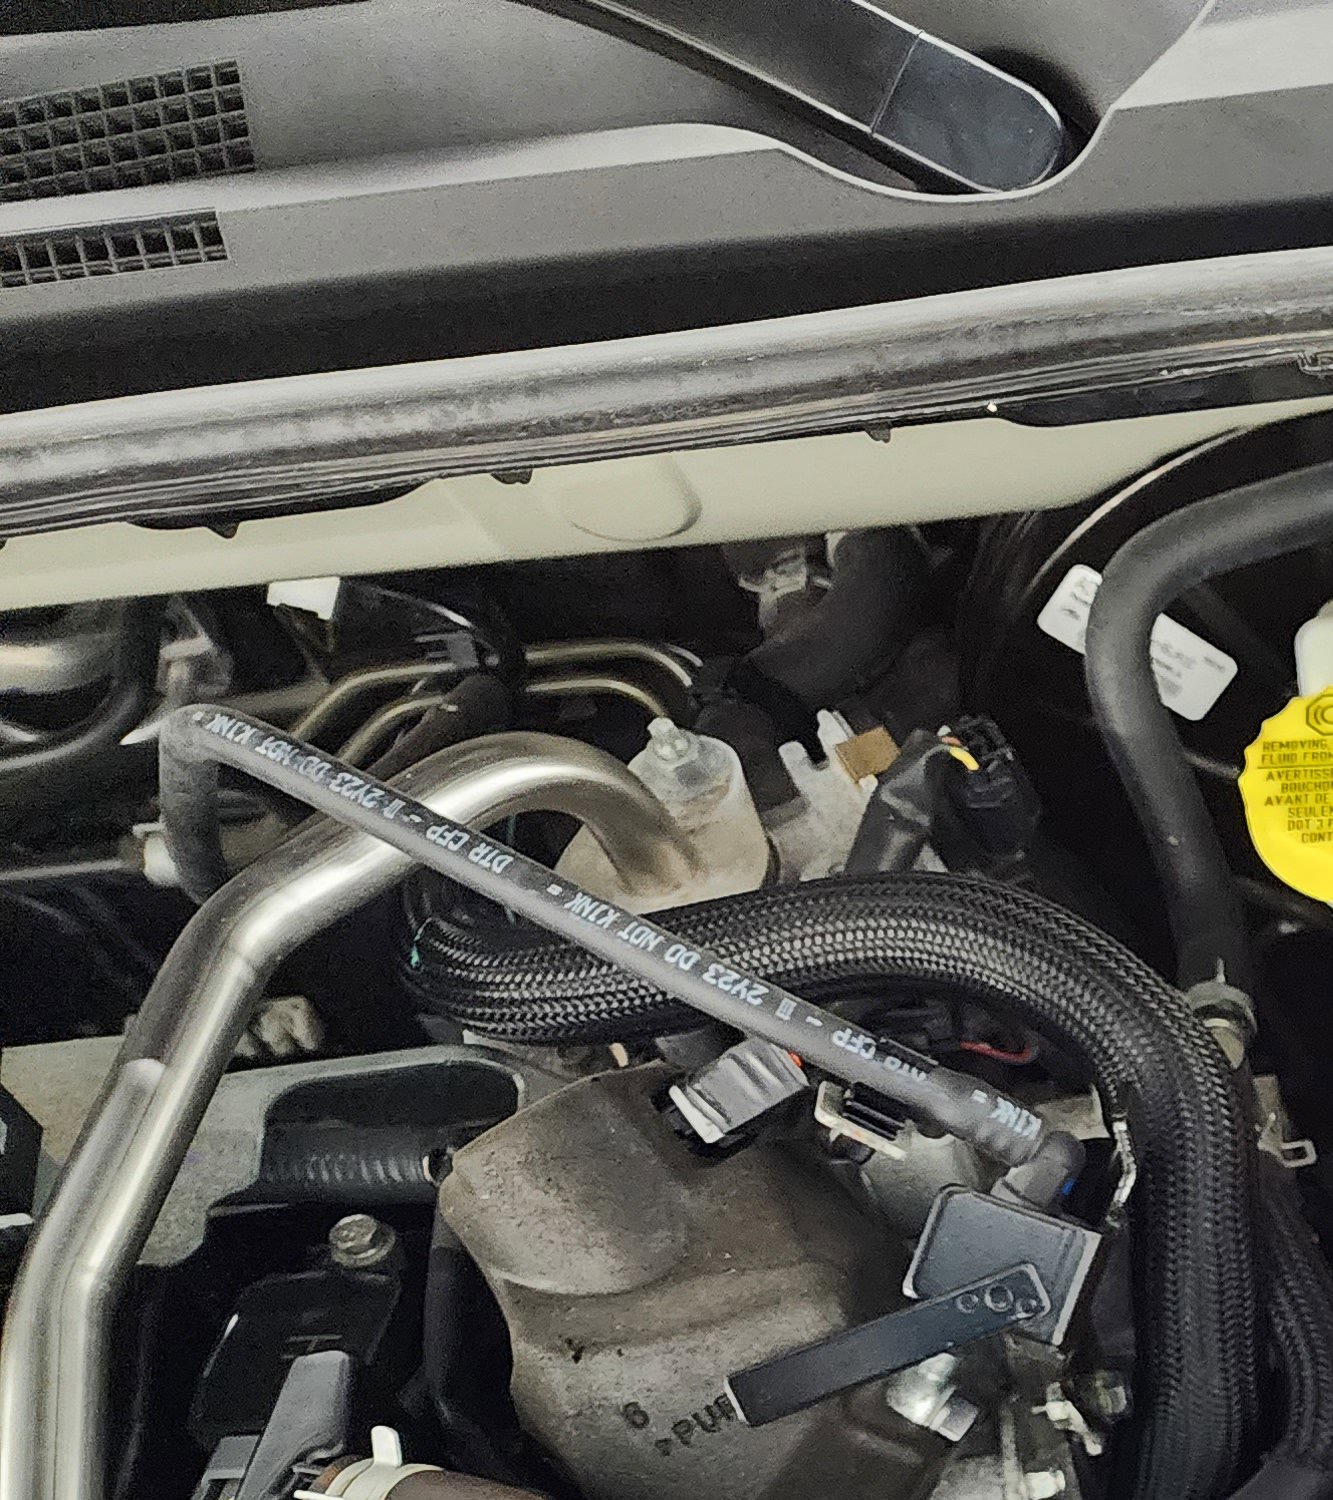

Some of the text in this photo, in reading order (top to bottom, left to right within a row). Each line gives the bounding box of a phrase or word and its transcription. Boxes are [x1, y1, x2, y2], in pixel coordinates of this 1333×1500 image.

[1261, 752, 1298, 765] FLUID
[1264, 794, 1309, 807] AVANT
[1315, 793, 1329, 804] DE
[423, 816, 470, 855] CFP
[1287, 818, 1310, 831] DOT
[562, 887, 618, 932] KINK
[615, 913, 665, 954] NOT
[662, 939, 702, 974] DO
[828, 1021, 880, 1061] CFP
[986, 1094, 1045, 1141] KINK
